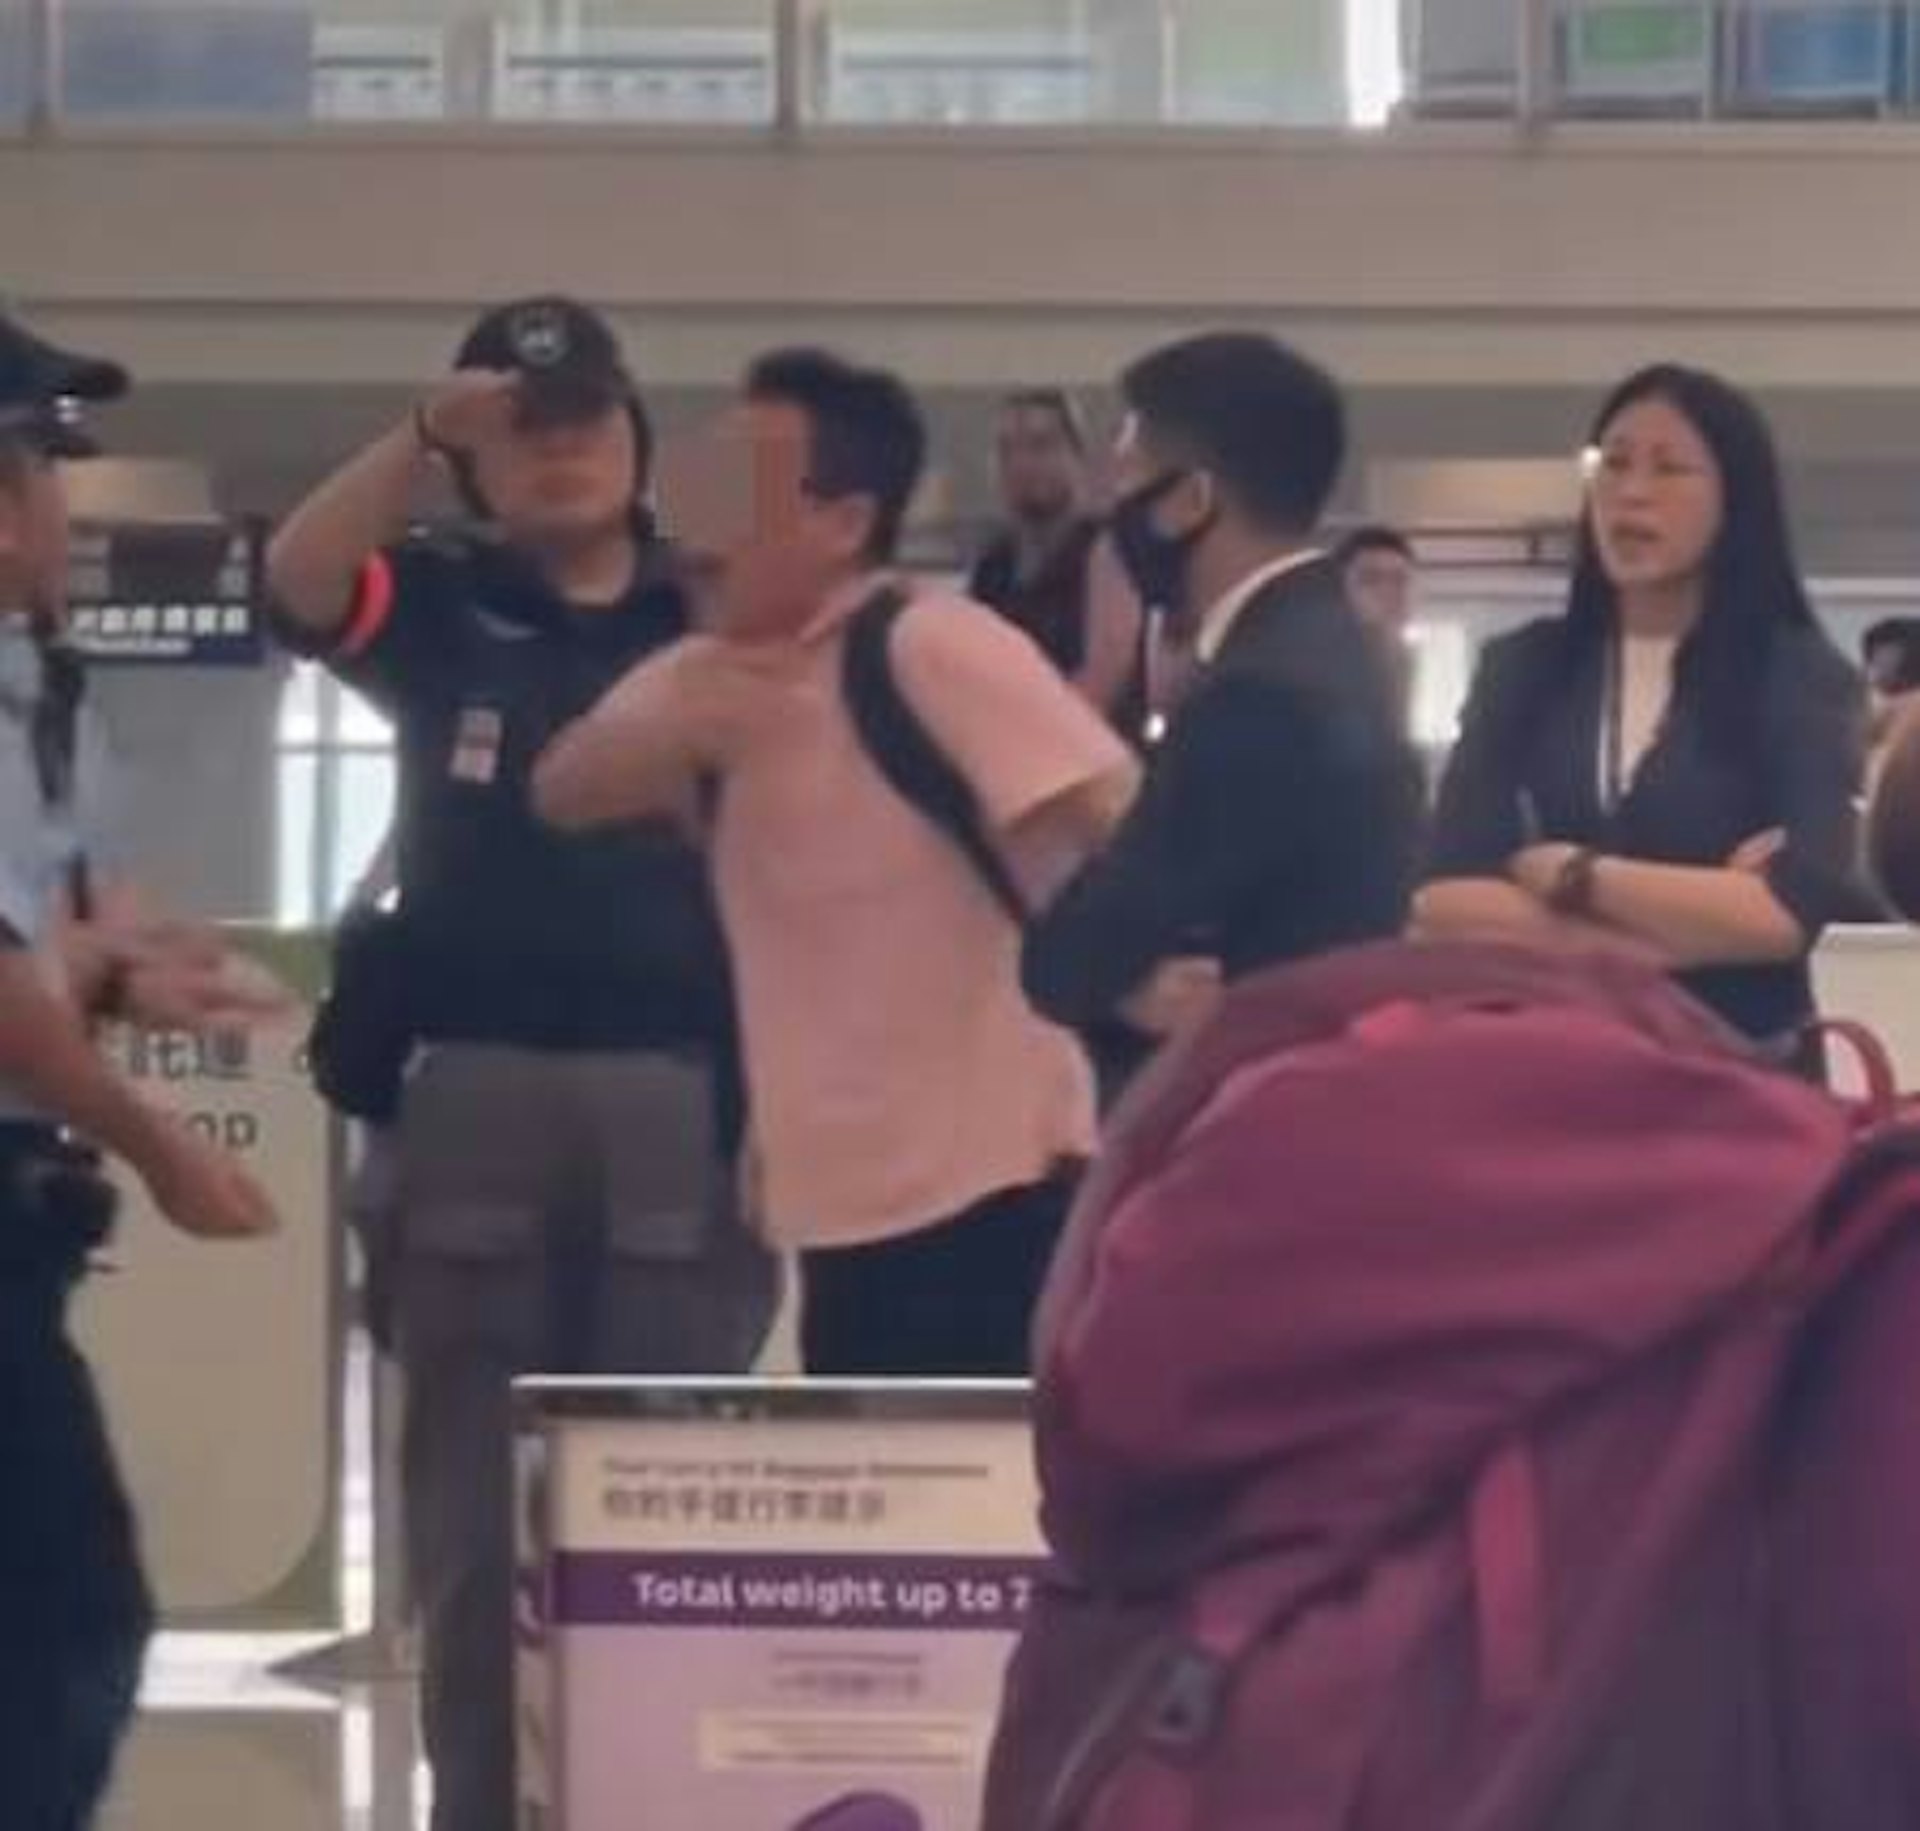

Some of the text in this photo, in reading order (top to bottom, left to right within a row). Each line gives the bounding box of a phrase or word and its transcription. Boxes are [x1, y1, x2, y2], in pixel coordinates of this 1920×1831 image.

[635, 1573, 735, 1608] Total
[742, 1575, 887, 1617] weight
[896, 1582, 947, 1618] up
[956, 1581, 1001, 1610] to
